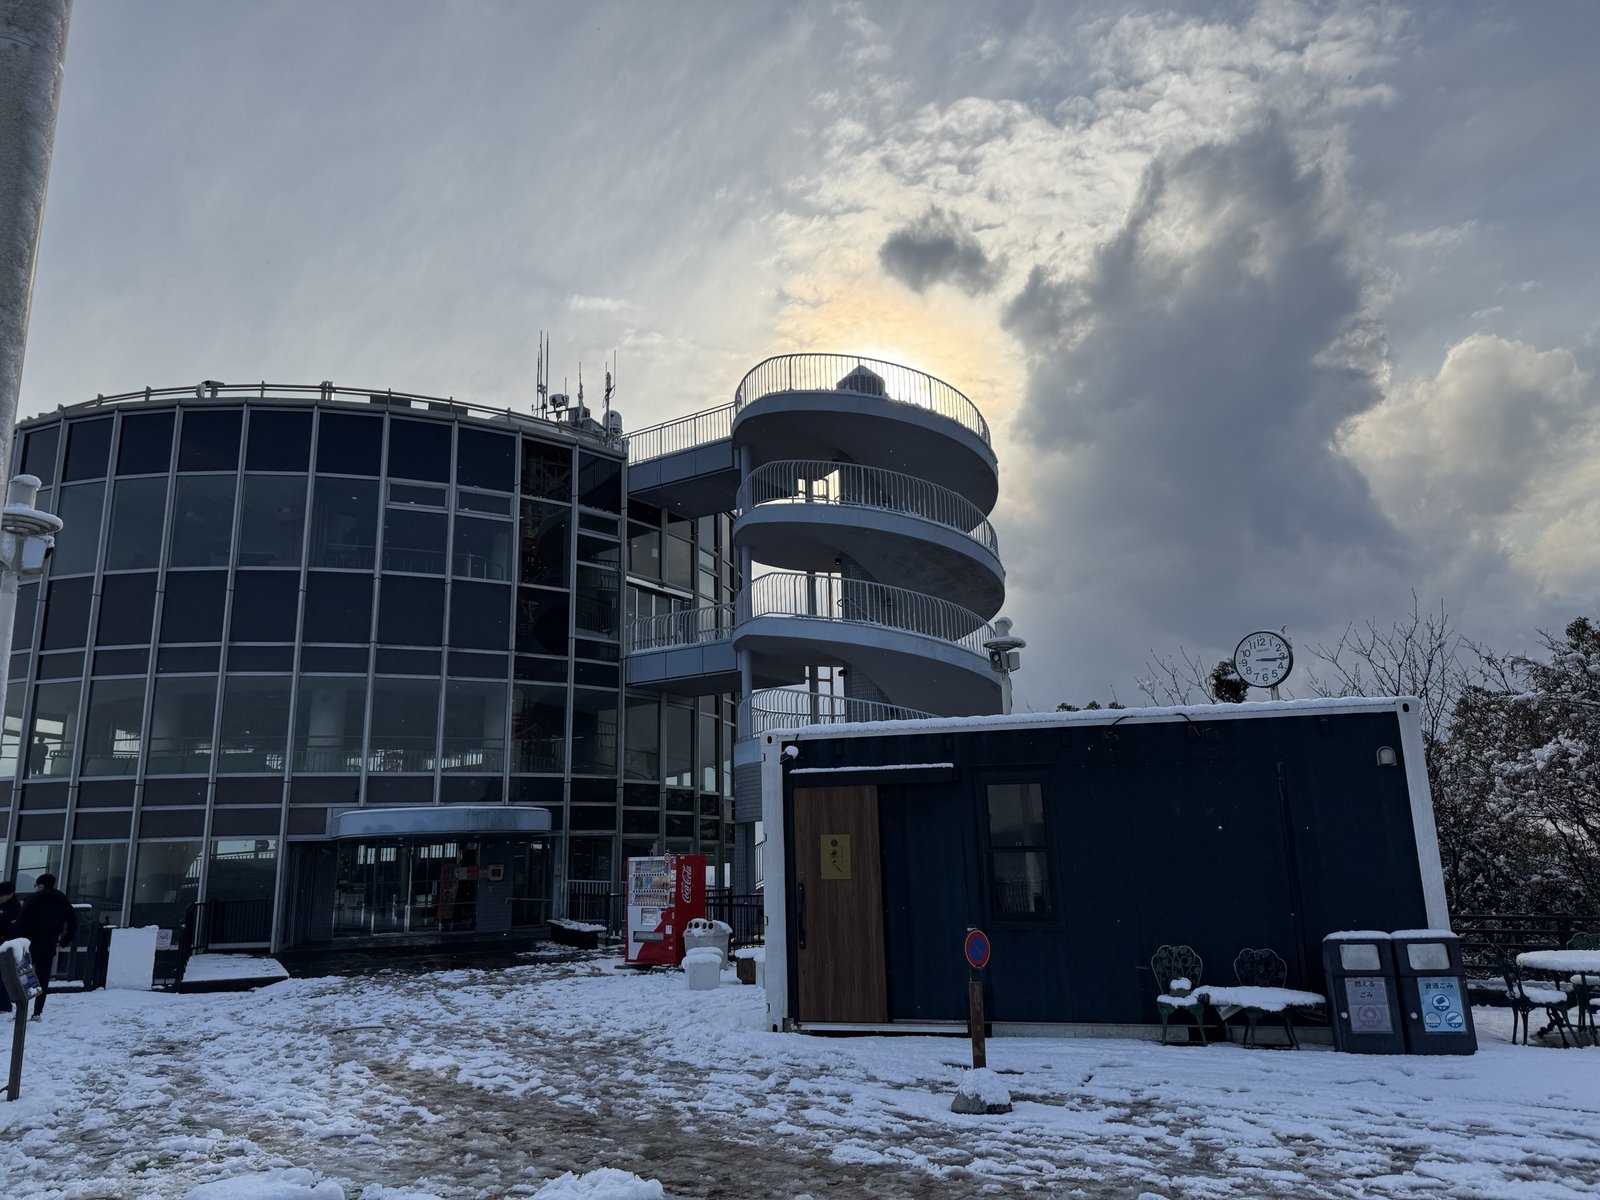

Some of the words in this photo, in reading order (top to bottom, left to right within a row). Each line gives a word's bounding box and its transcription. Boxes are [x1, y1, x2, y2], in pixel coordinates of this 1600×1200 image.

[1249, 641, 1256, 649] 11
[1257, 638, 1266, 646] 12
[1241, 649, 1251, 657] 10
[1241, 659, 1247, 667] 9
[1272, 670, 1278, 678] 5
[682, 864, 692, 903] Coca-Cola
